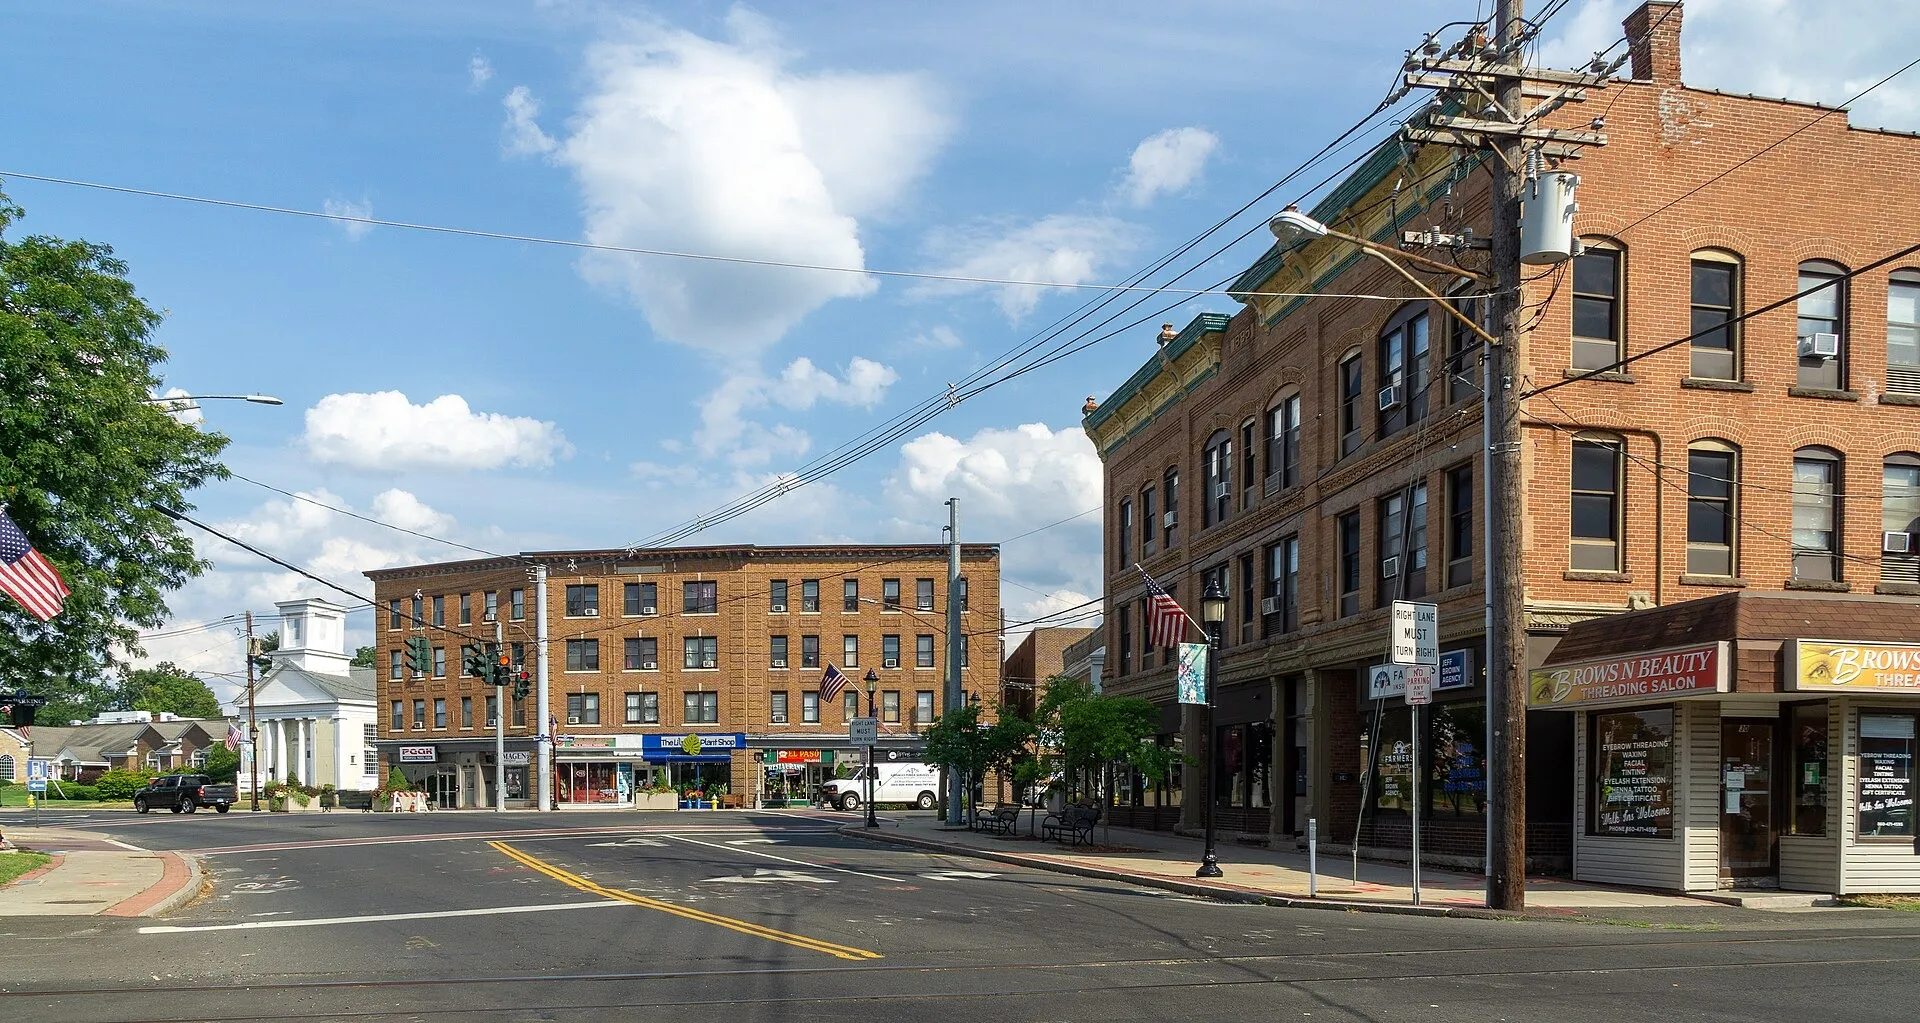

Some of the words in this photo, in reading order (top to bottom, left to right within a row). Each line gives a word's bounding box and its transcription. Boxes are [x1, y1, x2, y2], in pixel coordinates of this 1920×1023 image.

[1396, 609, 1416, 620] RIGHT
[1418, 611, 1435, 623] LANE
[1404, 627, 1427, 640] MUST
[1395, 645, 1413, 656] TURN
[1416, 647, 1436, 658] RIGHT
[1442, 658, 1452, 667] JEFF
[1413, 668, 1424, 677] NO
[1442, 665, 1461, 675] BROWN
[1406, 676, 1430, 685] PARKING
[1441, 673, 1462, 683] AGENCY
[1551, 663, 1618, 702] BROWS
[1621, 660, 1636, 681] N
[1638, 650, 1713, 679] BEAUTY
[1580, 681, 1648, 700] THREADING
[1651, 675, 1696, 691] SALON
[700, 738, 717, 746] Plant
[718, 738, 735, 748] Shop
[1603, 742, 1631, 750] EYEBROW
[1633, 741, 1668, 749] THREADING
[1384, 754, 1412, 763] FARMERS
[1621, 768, 1646, 776] TINTING
[1604, 777, 1631, 785] EYELASH
[1632, 776, 1666, 784] EXTENSION
[1622, 794, 1661, 802] CERTIFICATE
[1884, 797, 1913, 808] Welcome
[1601, 811, 1621, 825] Walk
[1635, 805, 1671, 819] Welcome
